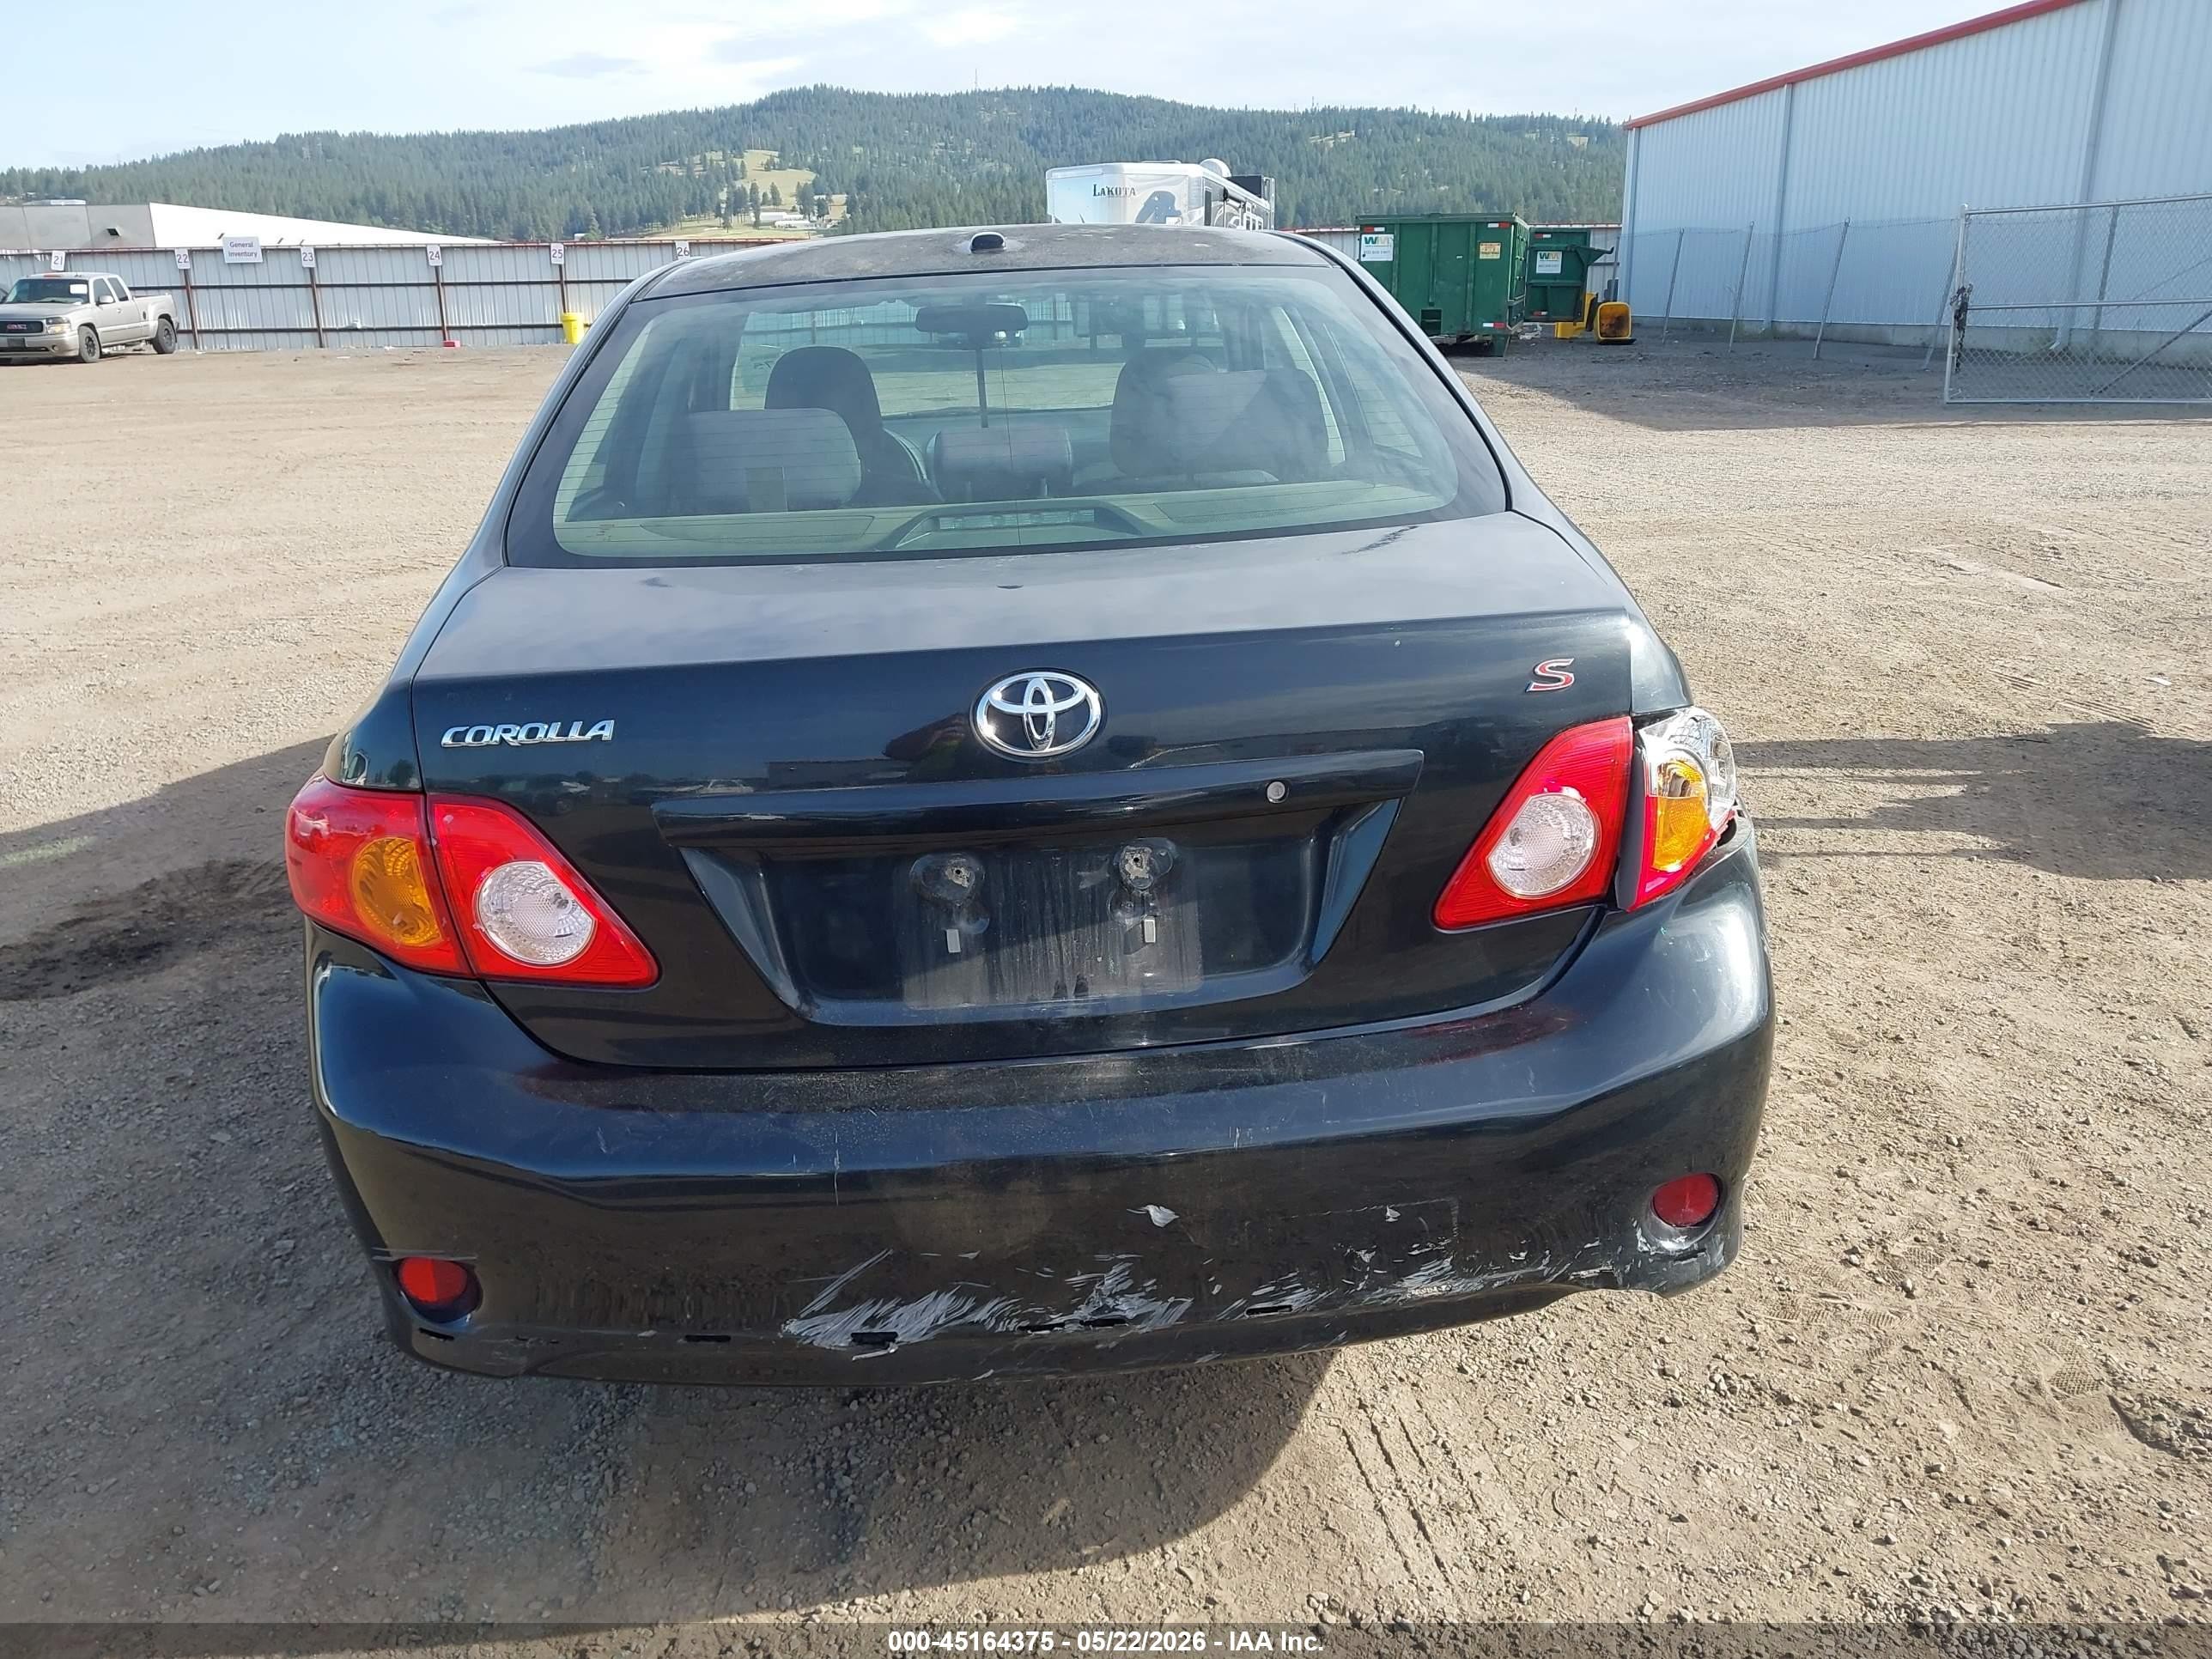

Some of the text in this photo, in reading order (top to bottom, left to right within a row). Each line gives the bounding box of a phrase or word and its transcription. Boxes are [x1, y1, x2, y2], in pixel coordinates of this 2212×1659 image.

[1093, 184, 1136, 197] LAKOTA
[302, 252, 313, 262] 23
[429, 251, 441, 261] 24
[551, 248, 563, 258] 25
[677, 246, 690, 257] 26
[53, 255, 63, 265] 21
[176, 253, 189, 264] 22
[1525, 658, 1574, 692] S
[441, 719, 616, 748] COROLLA
